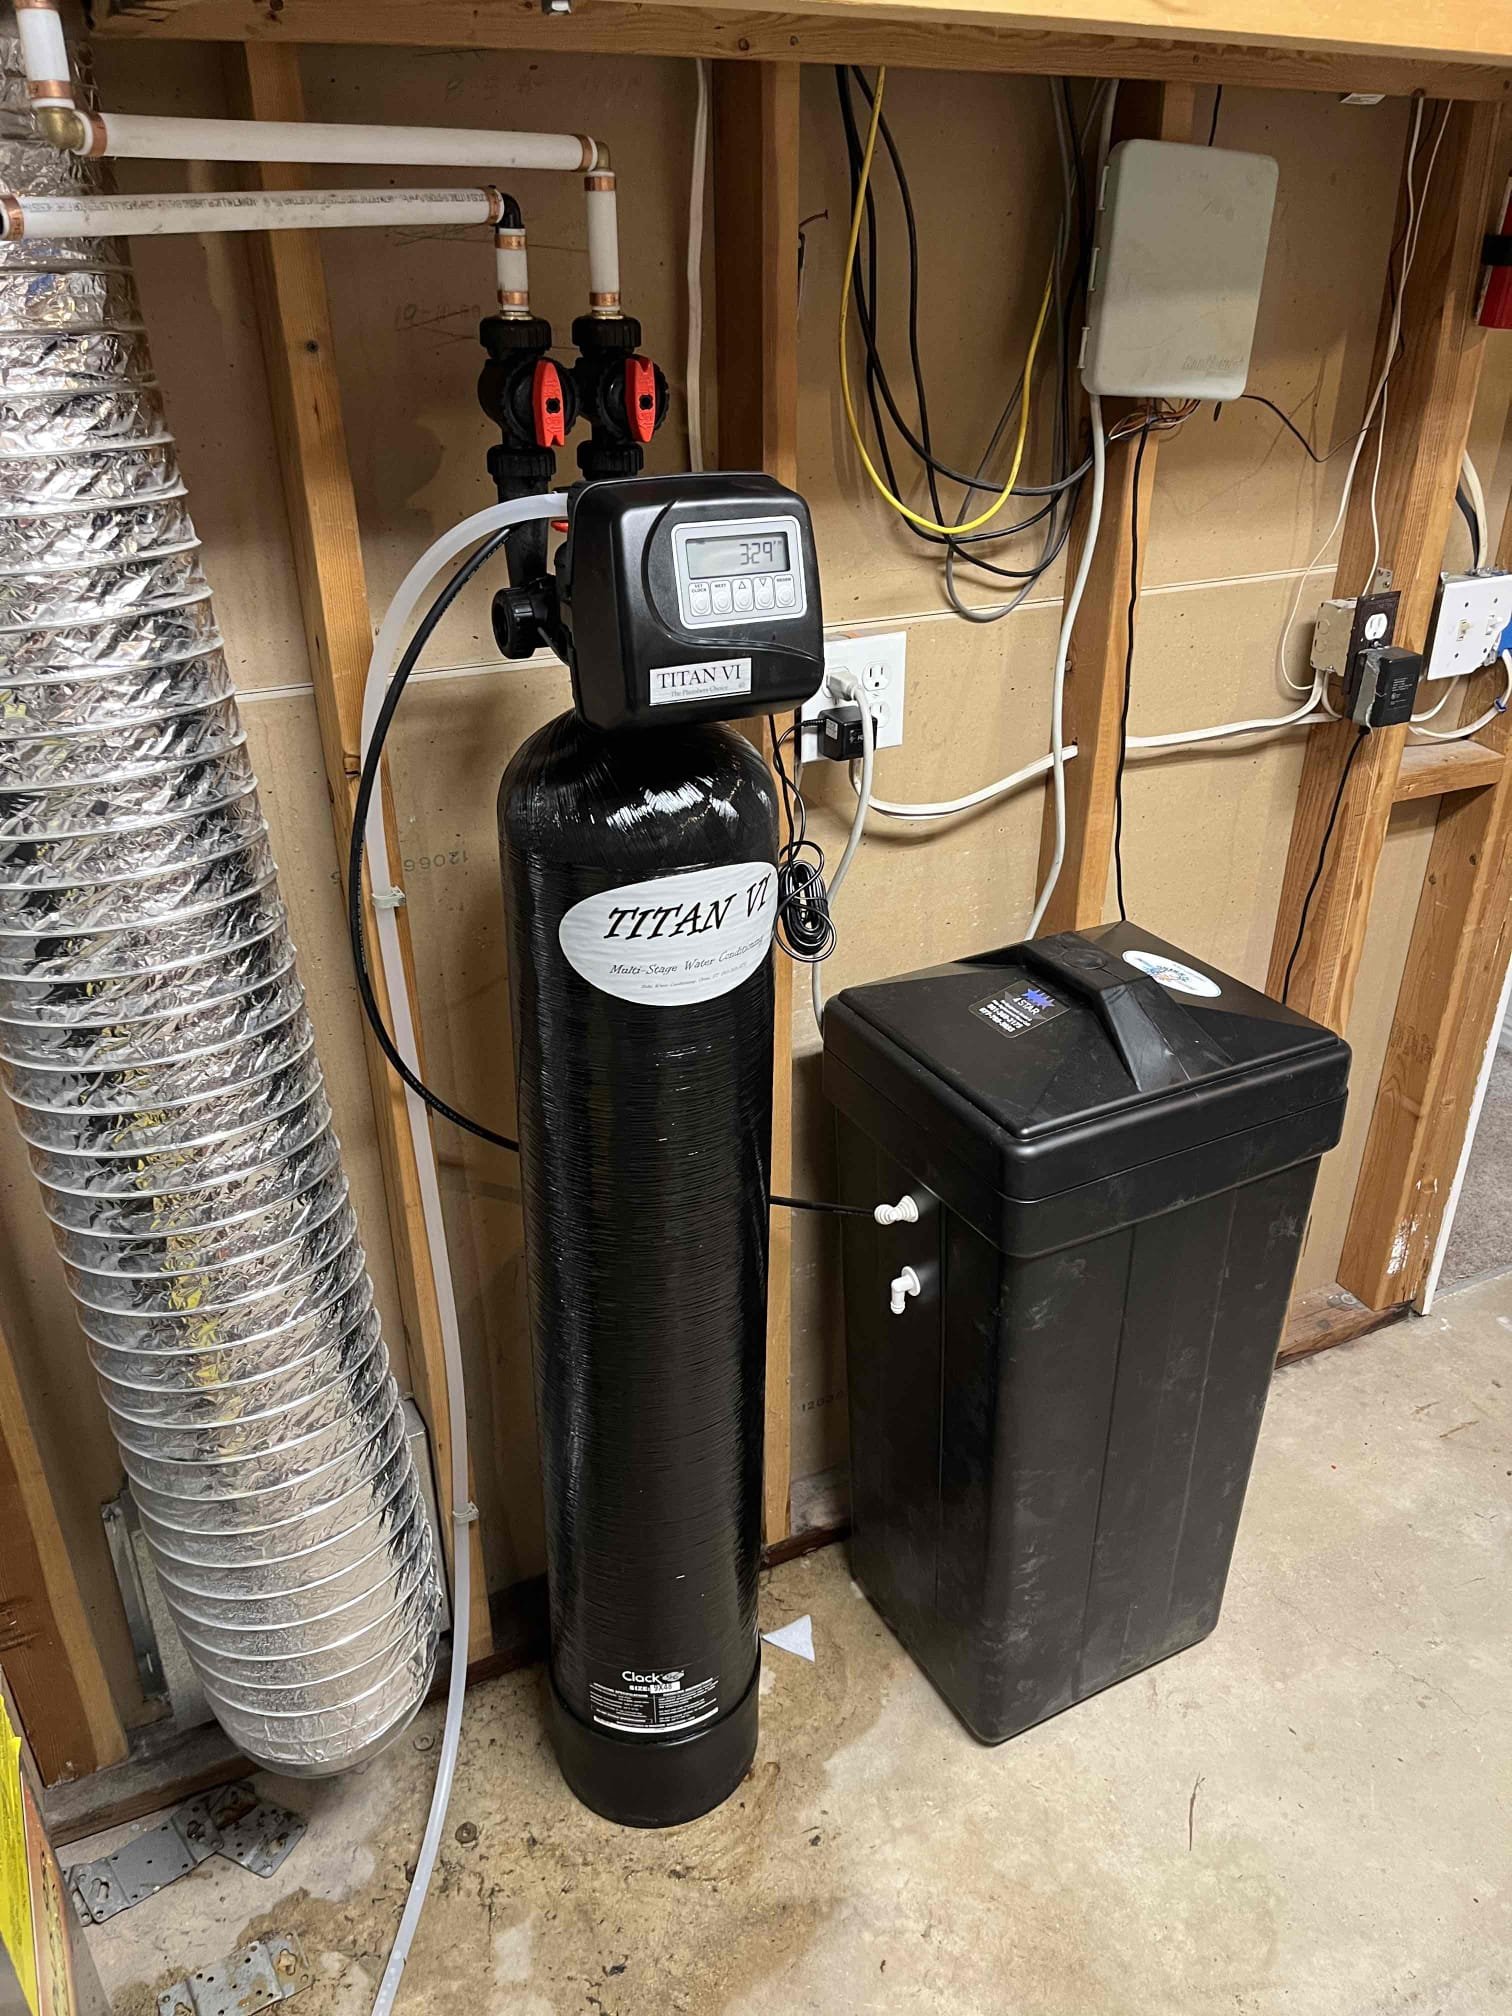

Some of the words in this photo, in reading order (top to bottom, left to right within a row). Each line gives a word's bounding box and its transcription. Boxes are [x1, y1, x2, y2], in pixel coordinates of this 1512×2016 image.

[656, 666, 716, 689] TITAN
[722, 664, 741, 680] VI
[603, 893, 737, 940] TITAN
[746, 872, 771, 917] VI
[609, 963, 678, 976] Multi-Stage
[684, 958, 715, 971] Water
[621, 1671, 663, 1685] Clack
